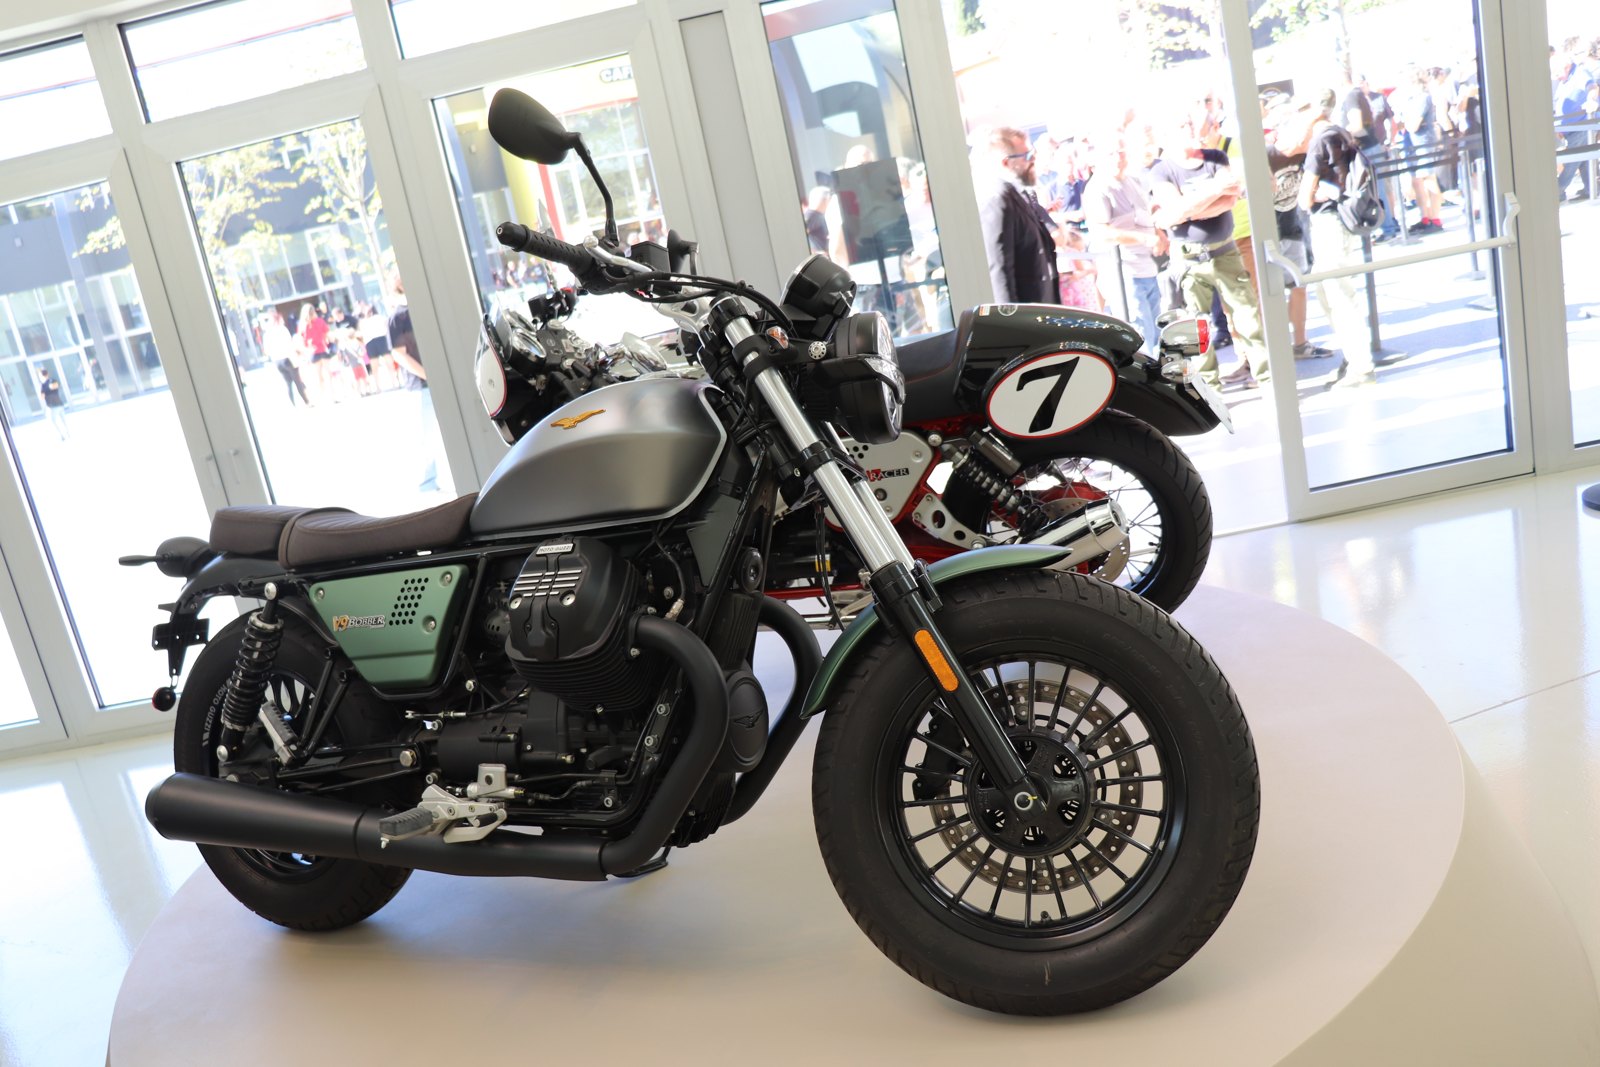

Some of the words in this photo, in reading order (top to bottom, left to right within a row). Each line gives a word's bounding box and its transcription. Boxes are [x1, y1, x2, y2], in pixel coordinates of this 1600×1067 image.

[1016, 356, 1080, 433] 7
[870, 468, 909, 480] RACER
[350, 615, 385, 628] BOBBER
[204, 706, 216, 732] GUZZI
